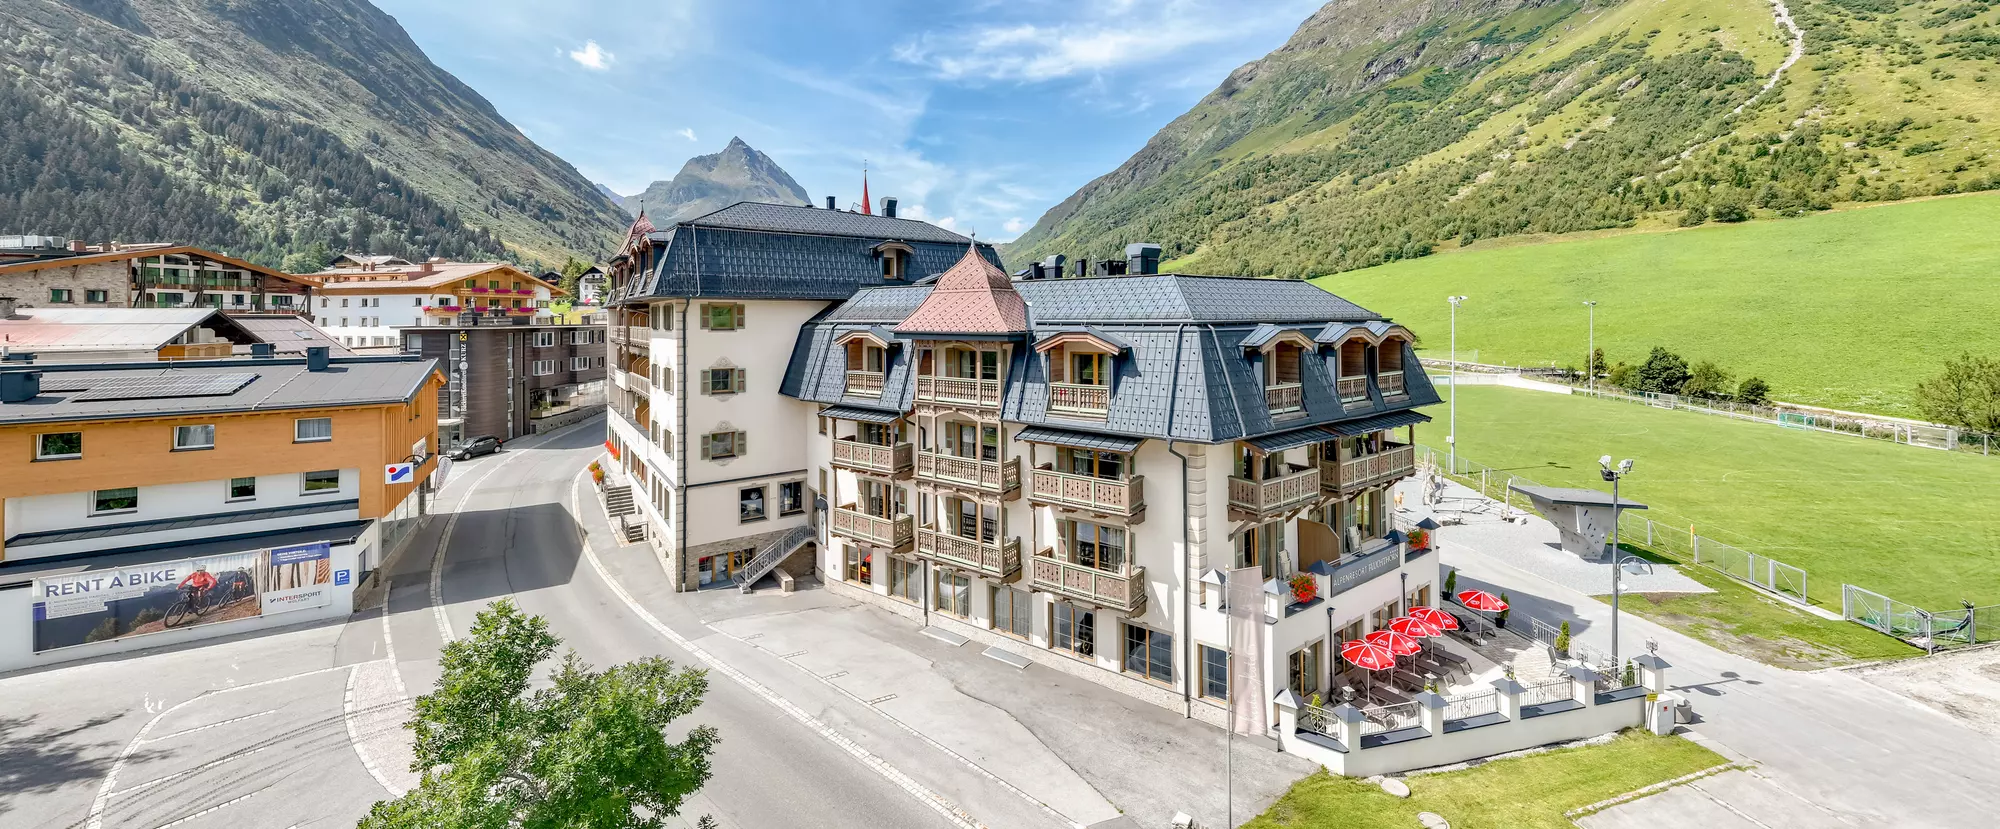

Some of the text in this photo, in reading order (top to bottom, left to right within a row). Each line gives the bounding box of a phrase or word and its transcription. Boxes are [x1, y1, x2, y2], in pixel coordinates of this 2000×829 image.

[46, 569, 176, 597] RENT A BIKE
[337, 571, 347, 581] P
[1333, 566, 1367, 586] ALPENRESORT
[277, 590, 322, 602] INTERSPORT
